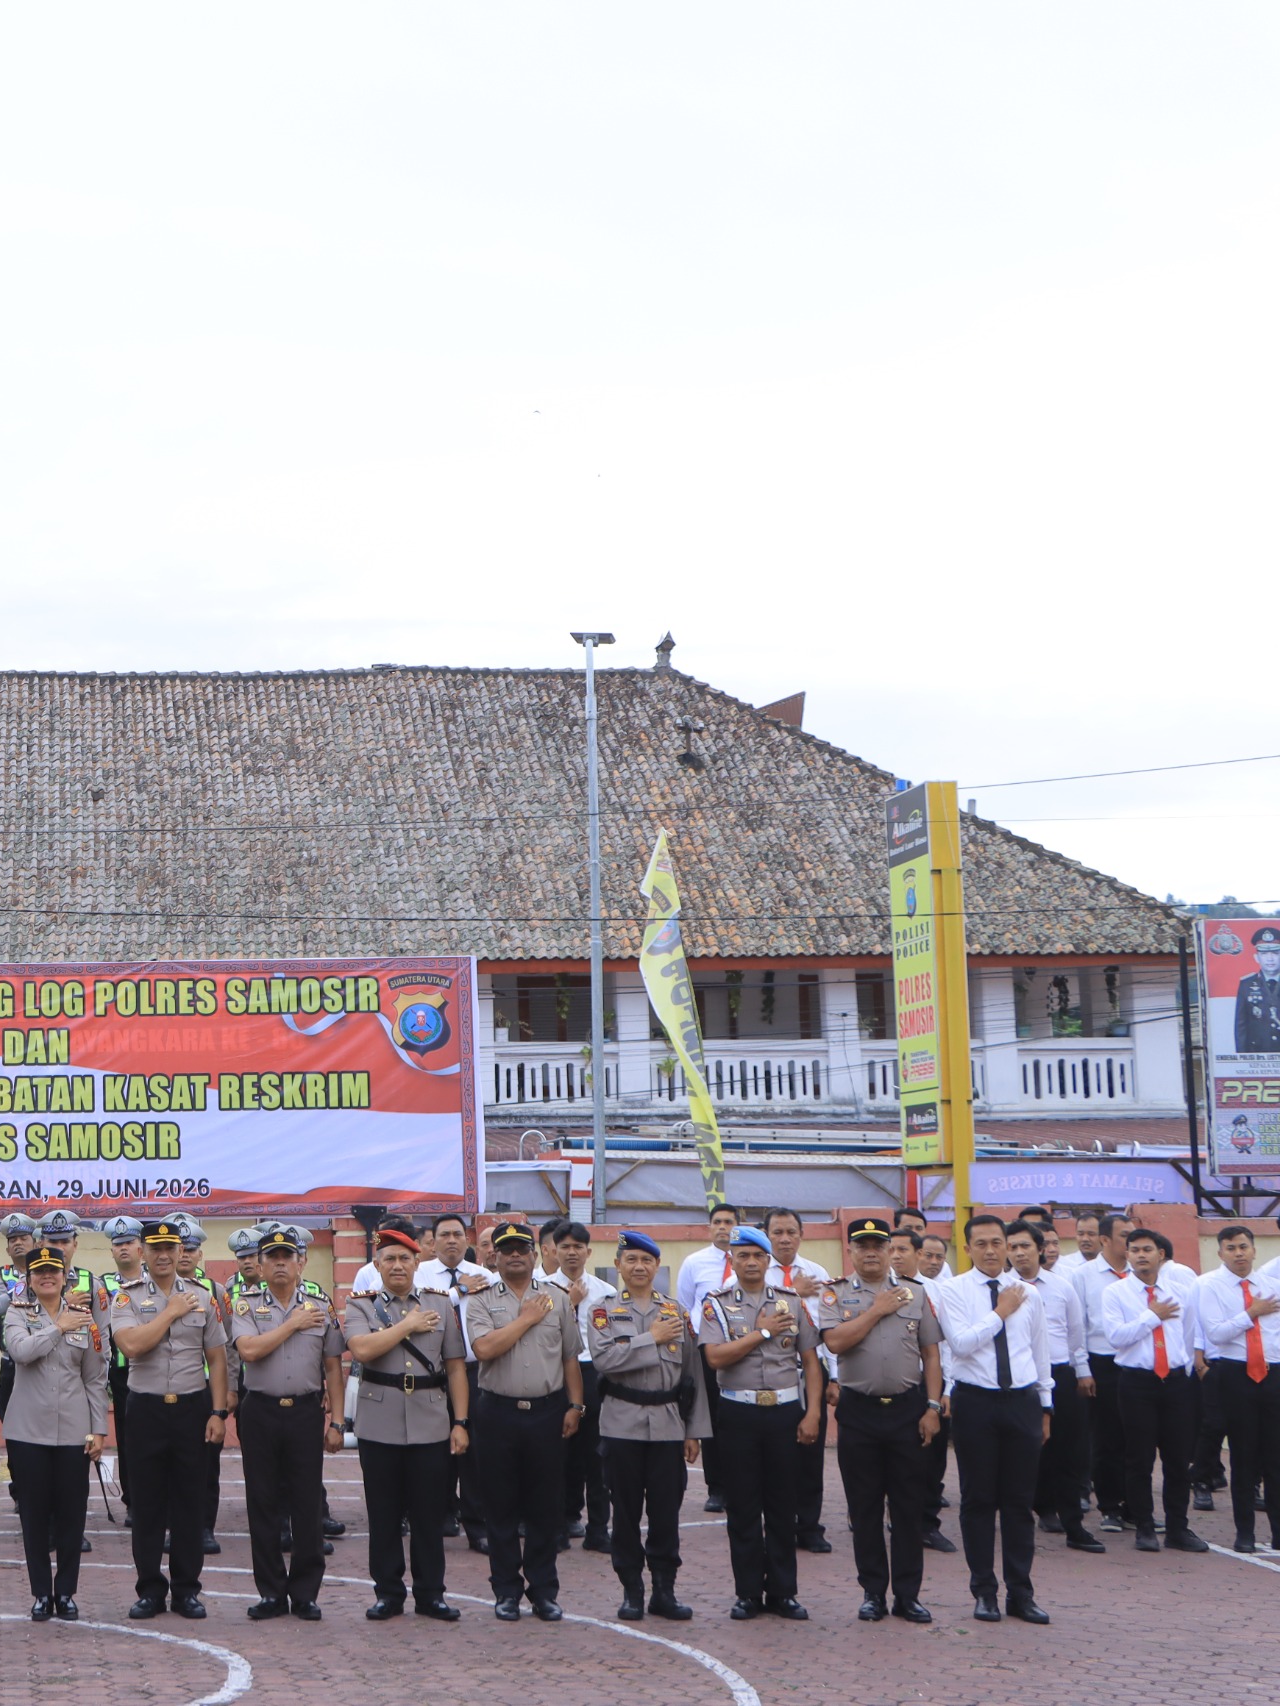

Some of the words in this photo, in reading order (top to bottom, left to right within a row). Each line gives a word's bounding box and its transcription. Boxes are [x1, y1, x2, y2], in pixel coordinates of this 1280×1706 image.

[892, 817, 922, 839] Alkaline
[896, 921, 929, 943] POLISI
[896, 939, 930, 960] POLICE
[23, 980, 86, 1018] LOG
[94, 978, 218, 1017] POLRES
[225, 976, 380, 1016] SAMOSIR
[390, 976, 427, 988] SUMATERA
[427, 976, 450, 987] UTARA
[898, 971, 932, 1007] POLRES
[898, 1005, 935, 1039] SAMOSIR
[2, 1028, 70, 1066] DAN
[103, 1073, 211, 1112] KASAT
[218, 1071, 371, 1110] RESKRIM
[25, 1121, 181, 1161] SAMOSIR
[57, 1179, 84, 1199] 29
[90, 1178, 148, 1199] JUNI
[155, 1177, 212, 1199] 2026
